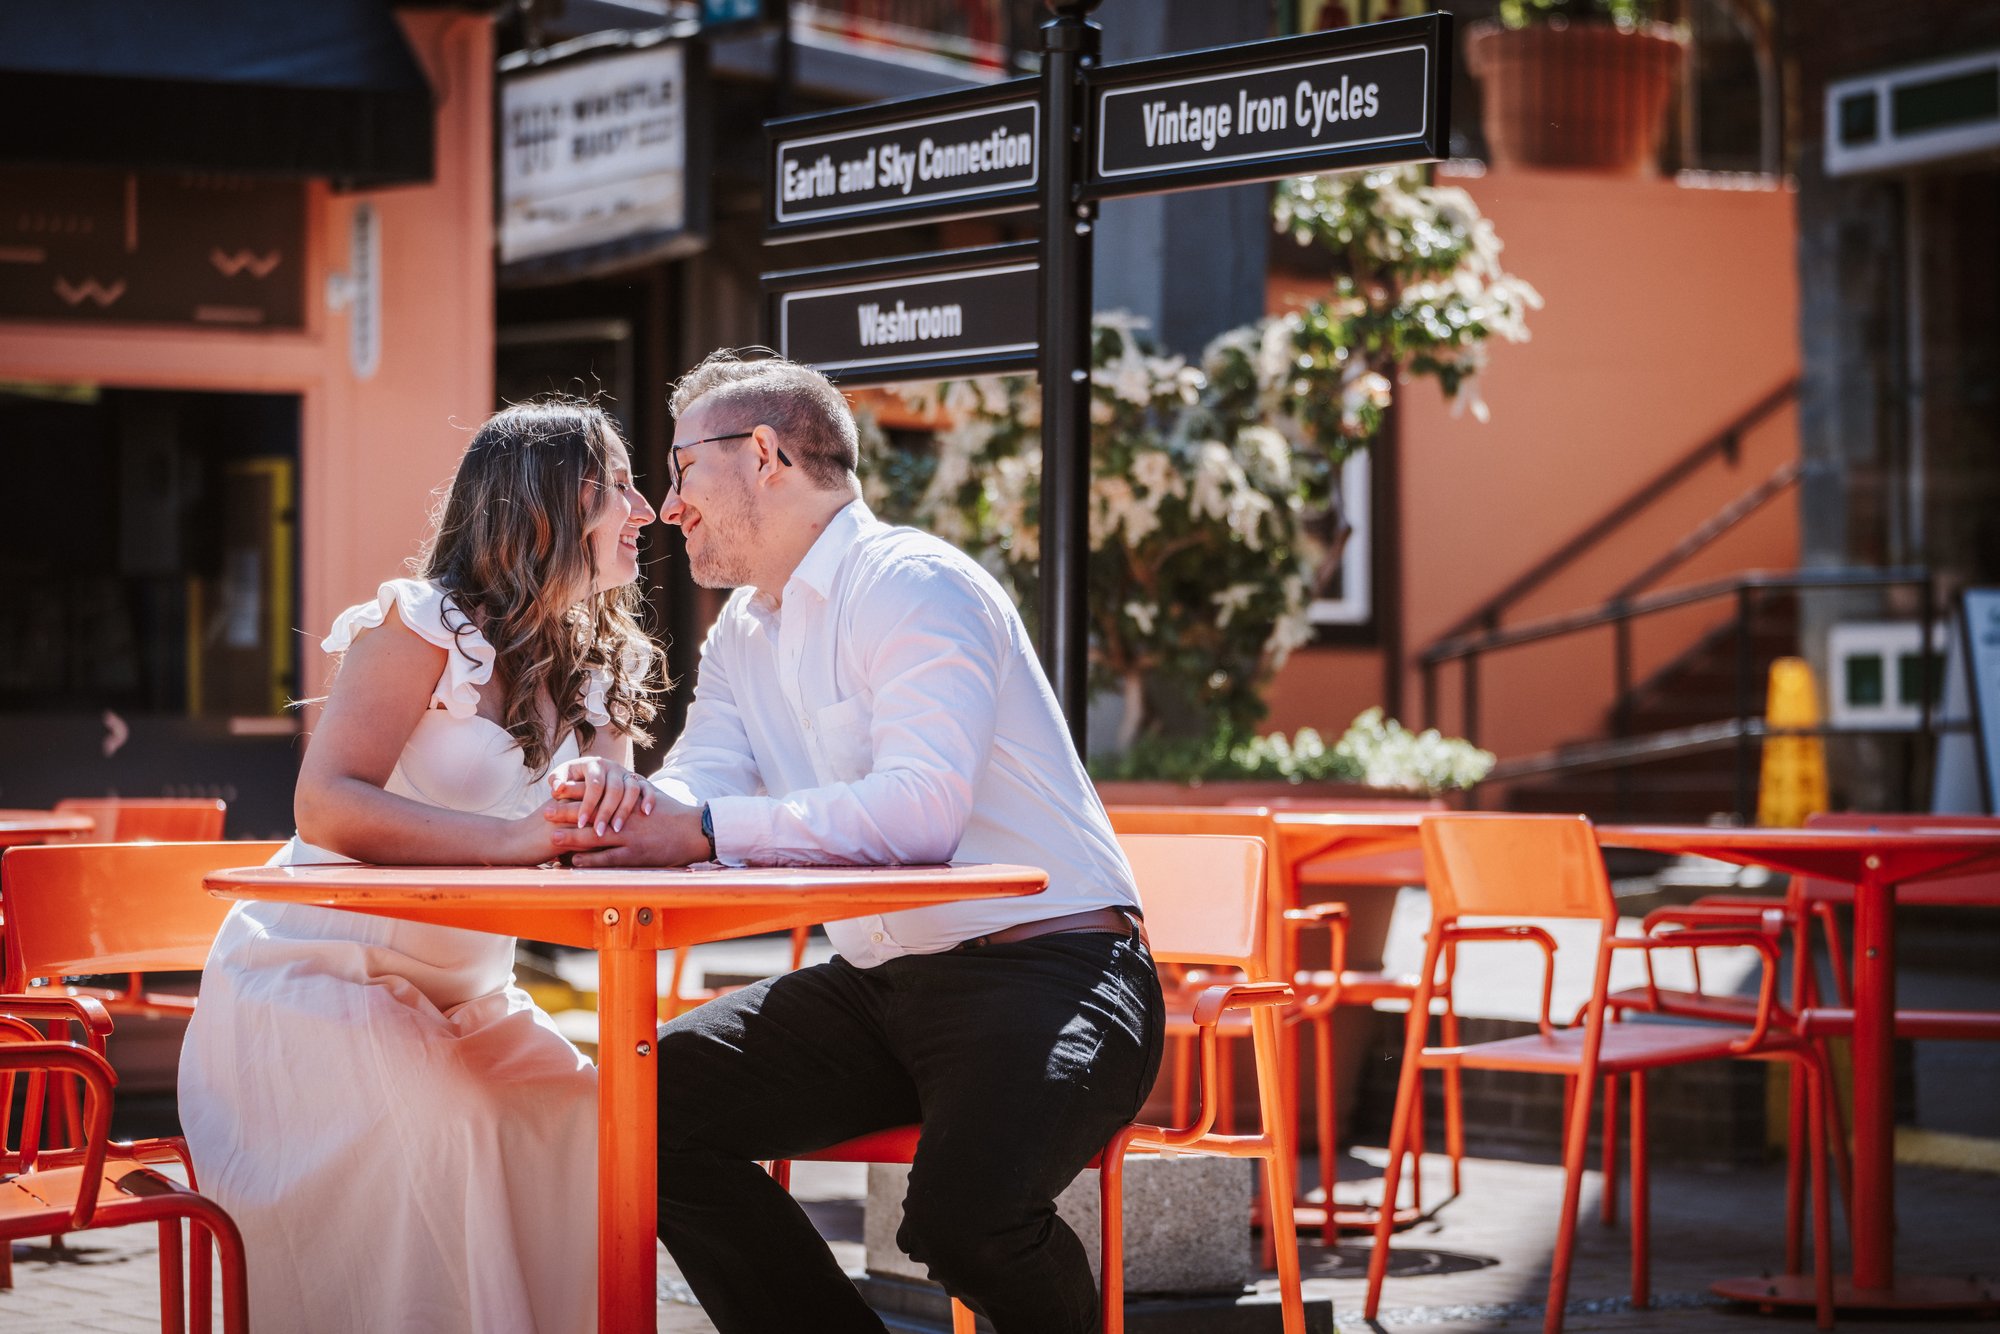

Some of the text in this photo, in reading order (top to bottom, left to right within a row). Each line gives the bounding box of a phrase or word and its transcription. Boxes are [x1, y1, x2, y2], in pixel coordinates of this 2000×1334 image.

[1143, 75, 1379, 151] Vintage Iron Cycles
[783, 125, 1031, 202] Earth and Sky Connection
[858, 300, 962, 347] Washroom
